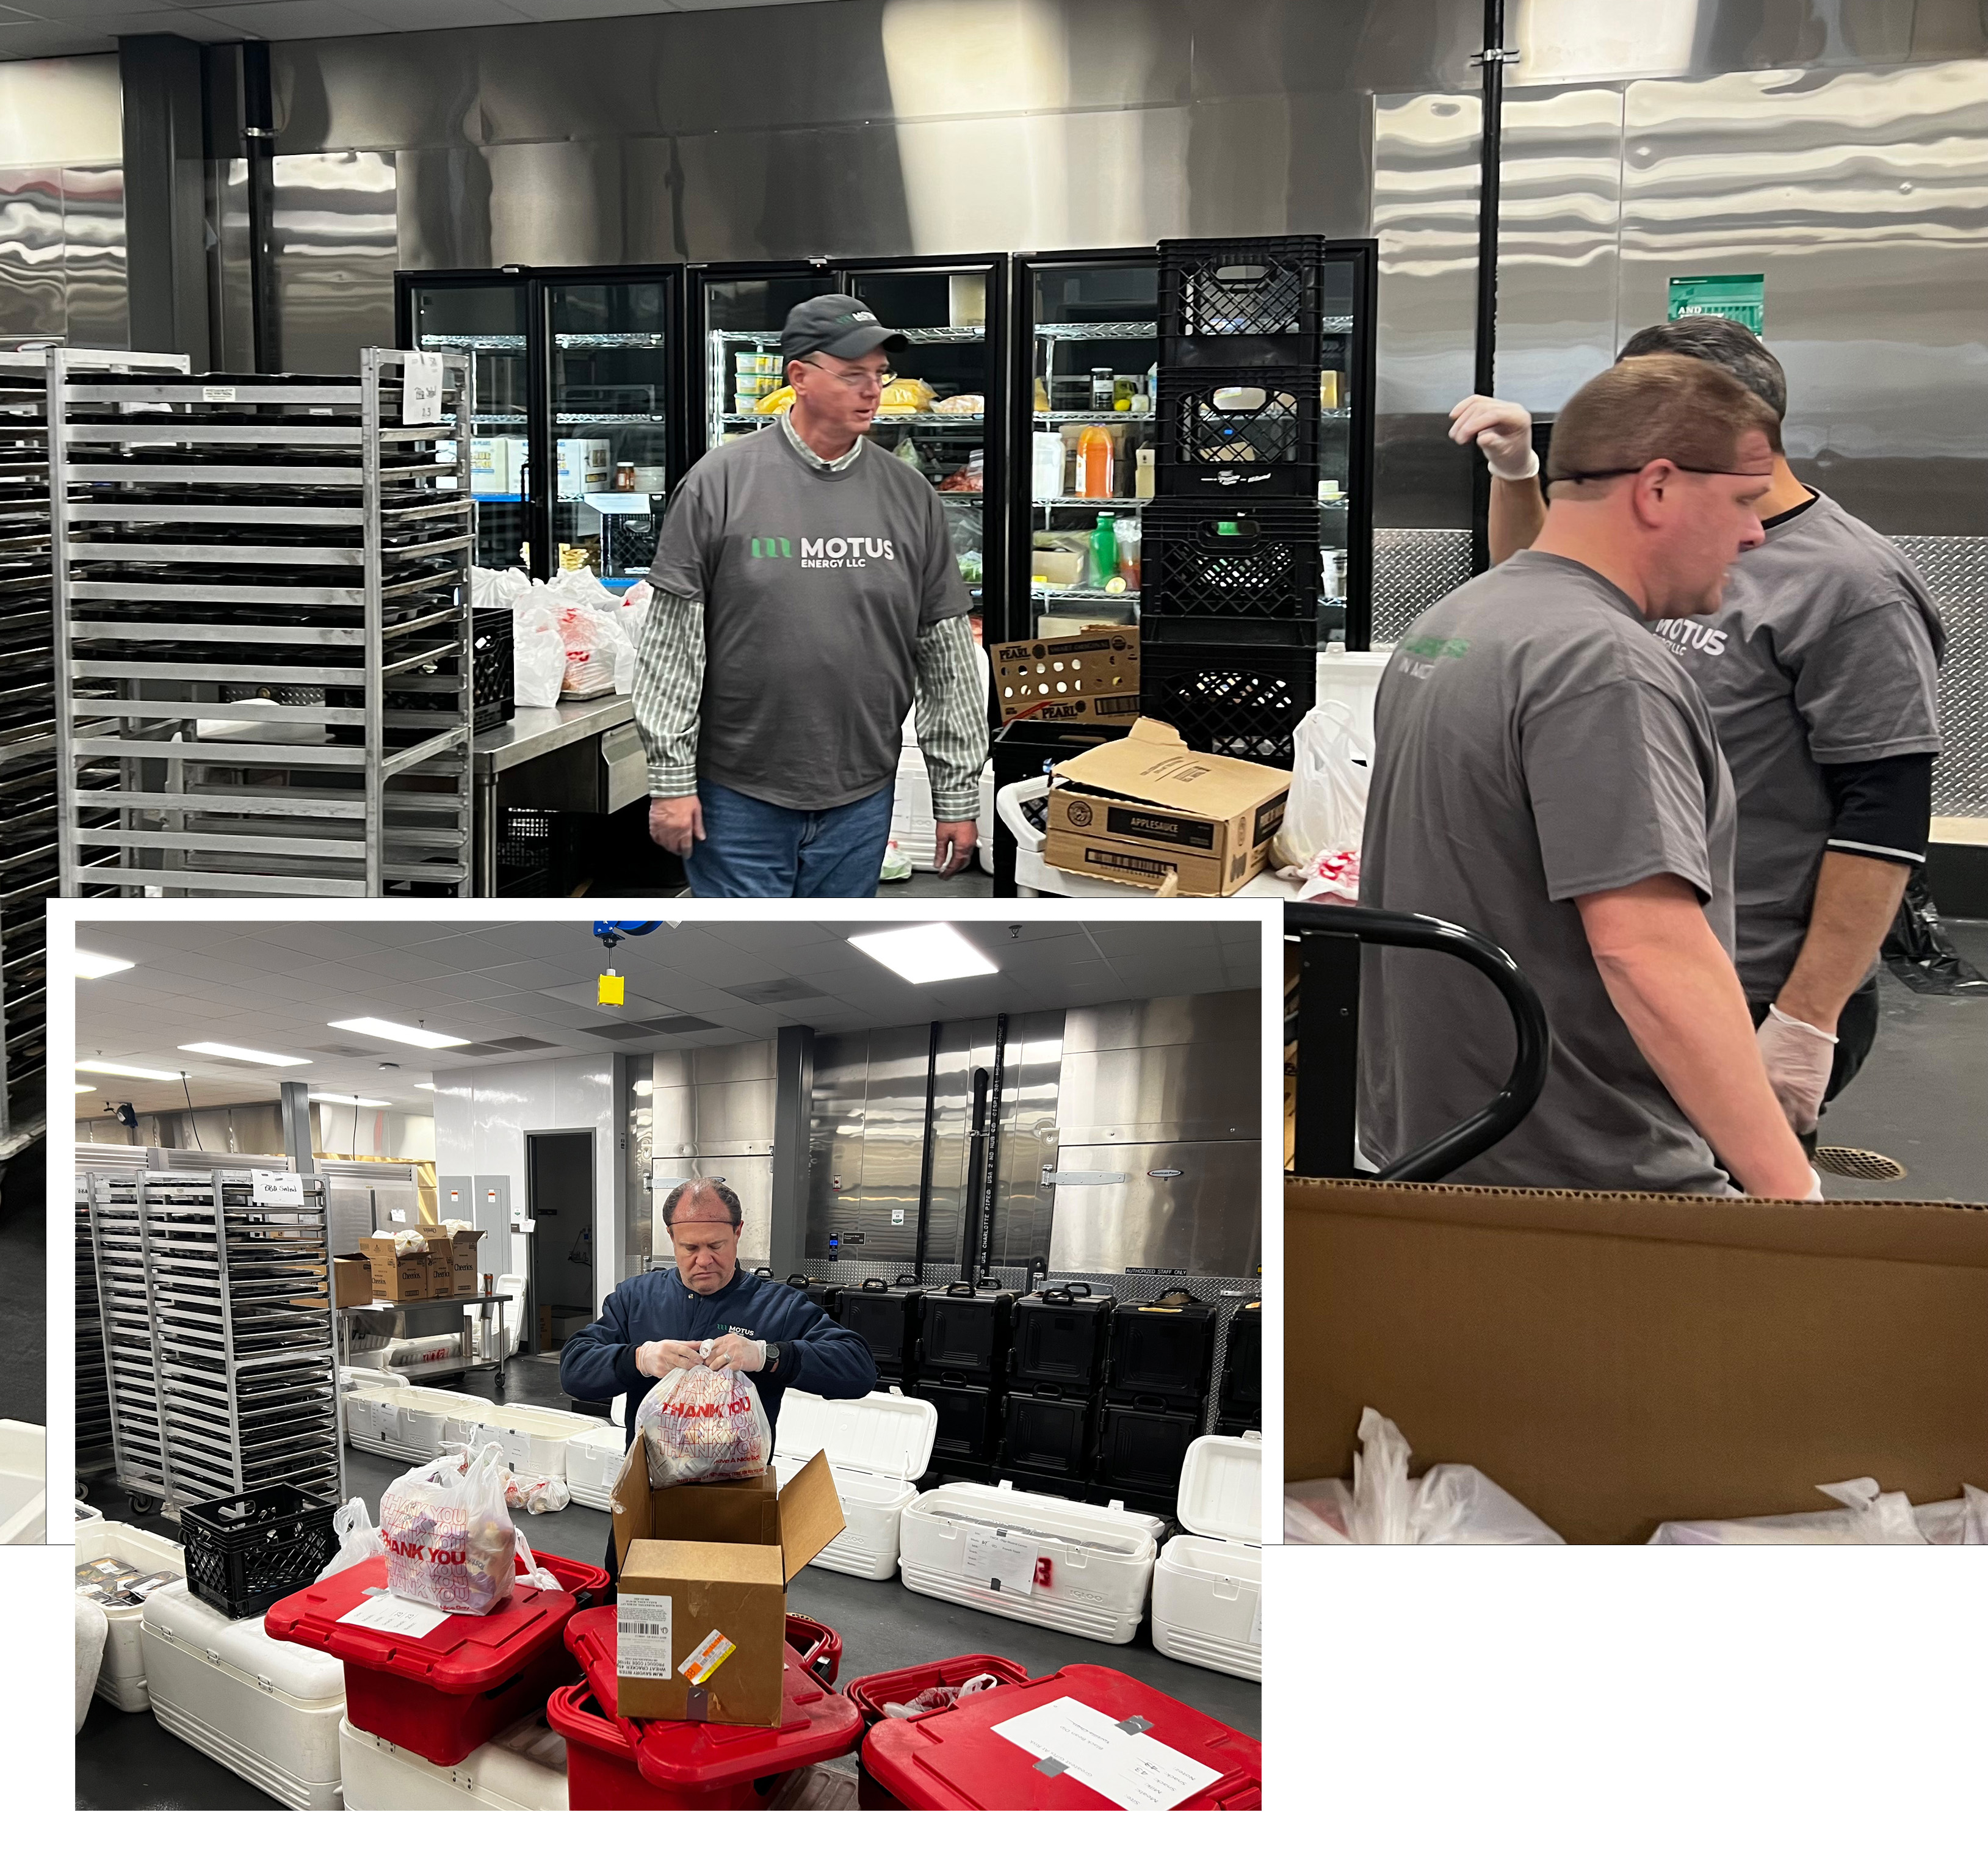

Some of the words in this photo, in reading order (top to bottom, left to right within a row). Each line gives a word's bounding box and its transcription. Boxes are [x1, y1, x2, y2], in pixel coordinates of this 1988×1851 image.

[801, 537, 894, 560] MOTUS
[801, 559, 844, 568] ENERGY
[846, 559, 866, 568] LLC
[1655, 618, 1728, 656] MOTUS
[999, 647, 1031, 660] PEARL
[1042, 705, 1078, 719] PEARL
[1130, 817, 1179, 833] APPLESAUCE
[989, 1151, 994, 1160] NO
[729, 1325, 754, 1336] MOTUS
[662, 1402, 725, 1418] THANK
[727, 1396, 751, 1416] YOU
[657, 1412, 724, 1430] THANK
[726, 1410, 756, 1429] YOU
[657, 1426, 723, 1444] THANK
[726, 1422, 759, 1443] YOU
[657, 1440, 723, 1458] THANK
[723, 1436, 761, 1455] YOU
[430, 1505, 466, 1525] YOU
[428, 1520, 466, 1539] YOU
[428, 1533, 466, 1552] YOU
[428, 1548, 466, 1565] YOU
[387, 1563, 424, 1583] HANK
[428, 1574, 468, 1588] YOU
[426, 1561, 467, 1578] YOU
[389, 1574, 428, 1599] HANK
[430, 1587, 470, 1603] YOU
[1069, 1588, 1103, 1603] IGLOO
[1029, 1740, 1042, 1748] Risk
[1071, 1732, 1086, 1741] Bean
[1088, 1742, 1104, 1750] Black
[1051, 1751, 1064, 1761] Gifts
[1065, 1760, 1093, 1777] Greatest
[1154, 1777, 1177, 1791] Snack:
[1164, 1772, 1187, 1786] Snack:
[1136, 1788, 1159, 1803] Meals:
[1144, 1783, 1162, 1794] Milk:
[1124, 1794, 1141, 1805] Site:
